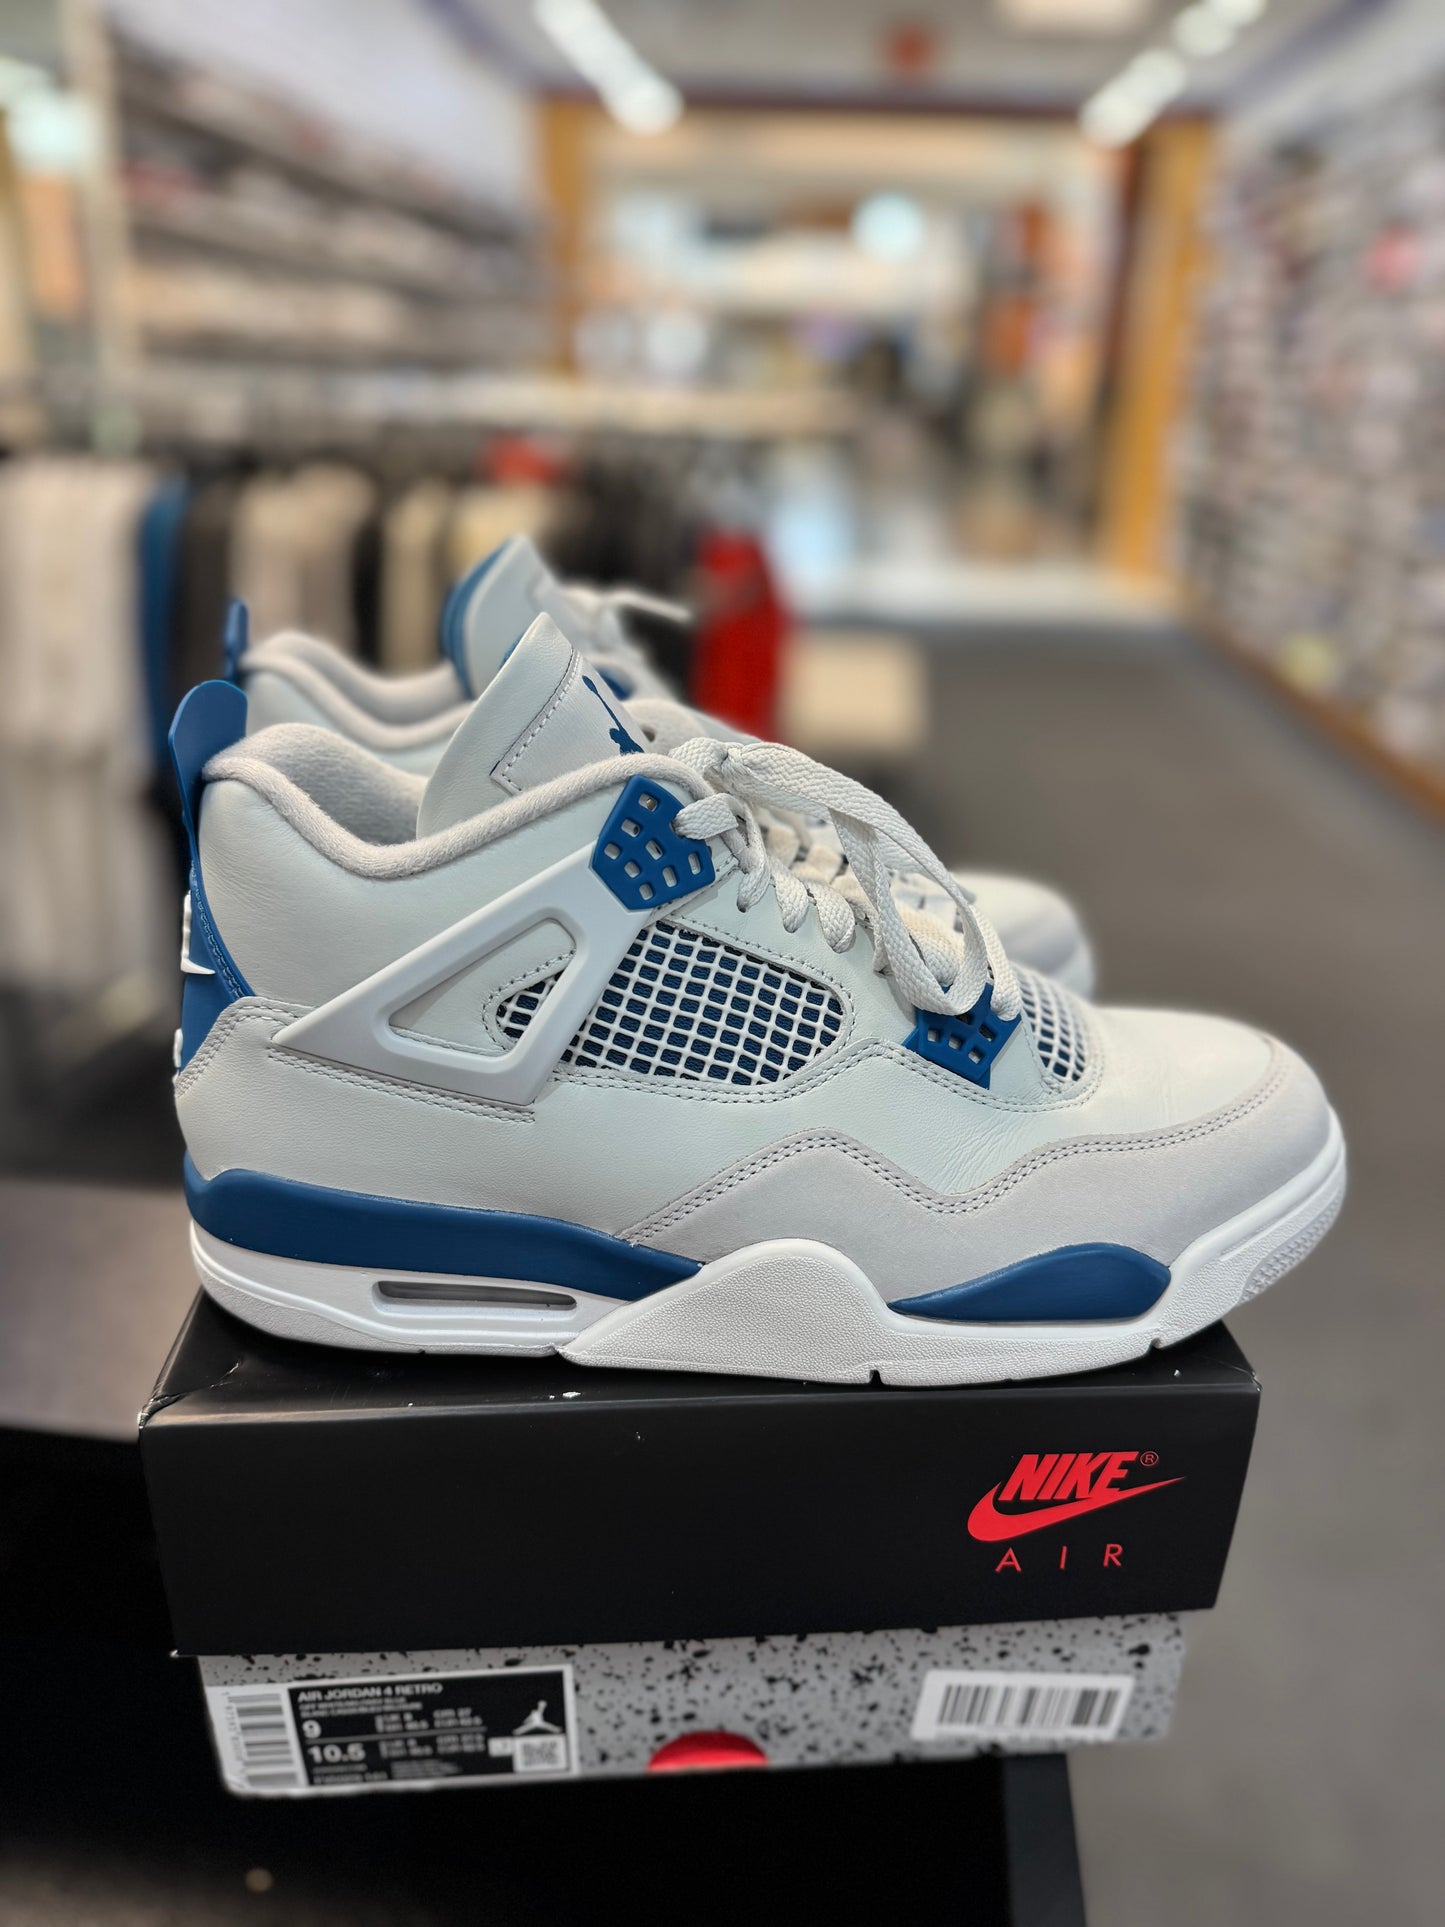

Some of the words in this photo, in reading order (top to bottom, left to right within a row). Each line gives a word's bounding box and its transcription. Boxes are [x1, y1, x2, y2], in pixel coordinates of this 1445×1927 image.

[998, 1451, 1139, 1501] NIKE
[297, 1690, 322, 1703] AIR
[324, 1686, 382, 1701] JORDAN
[383, 1685, 393, 1696] 4
[395, 1682, 443, 1696] RETRO
[302, 1719, 322, 1739] 9
[307, 1743, 367, 1764] 10.5
